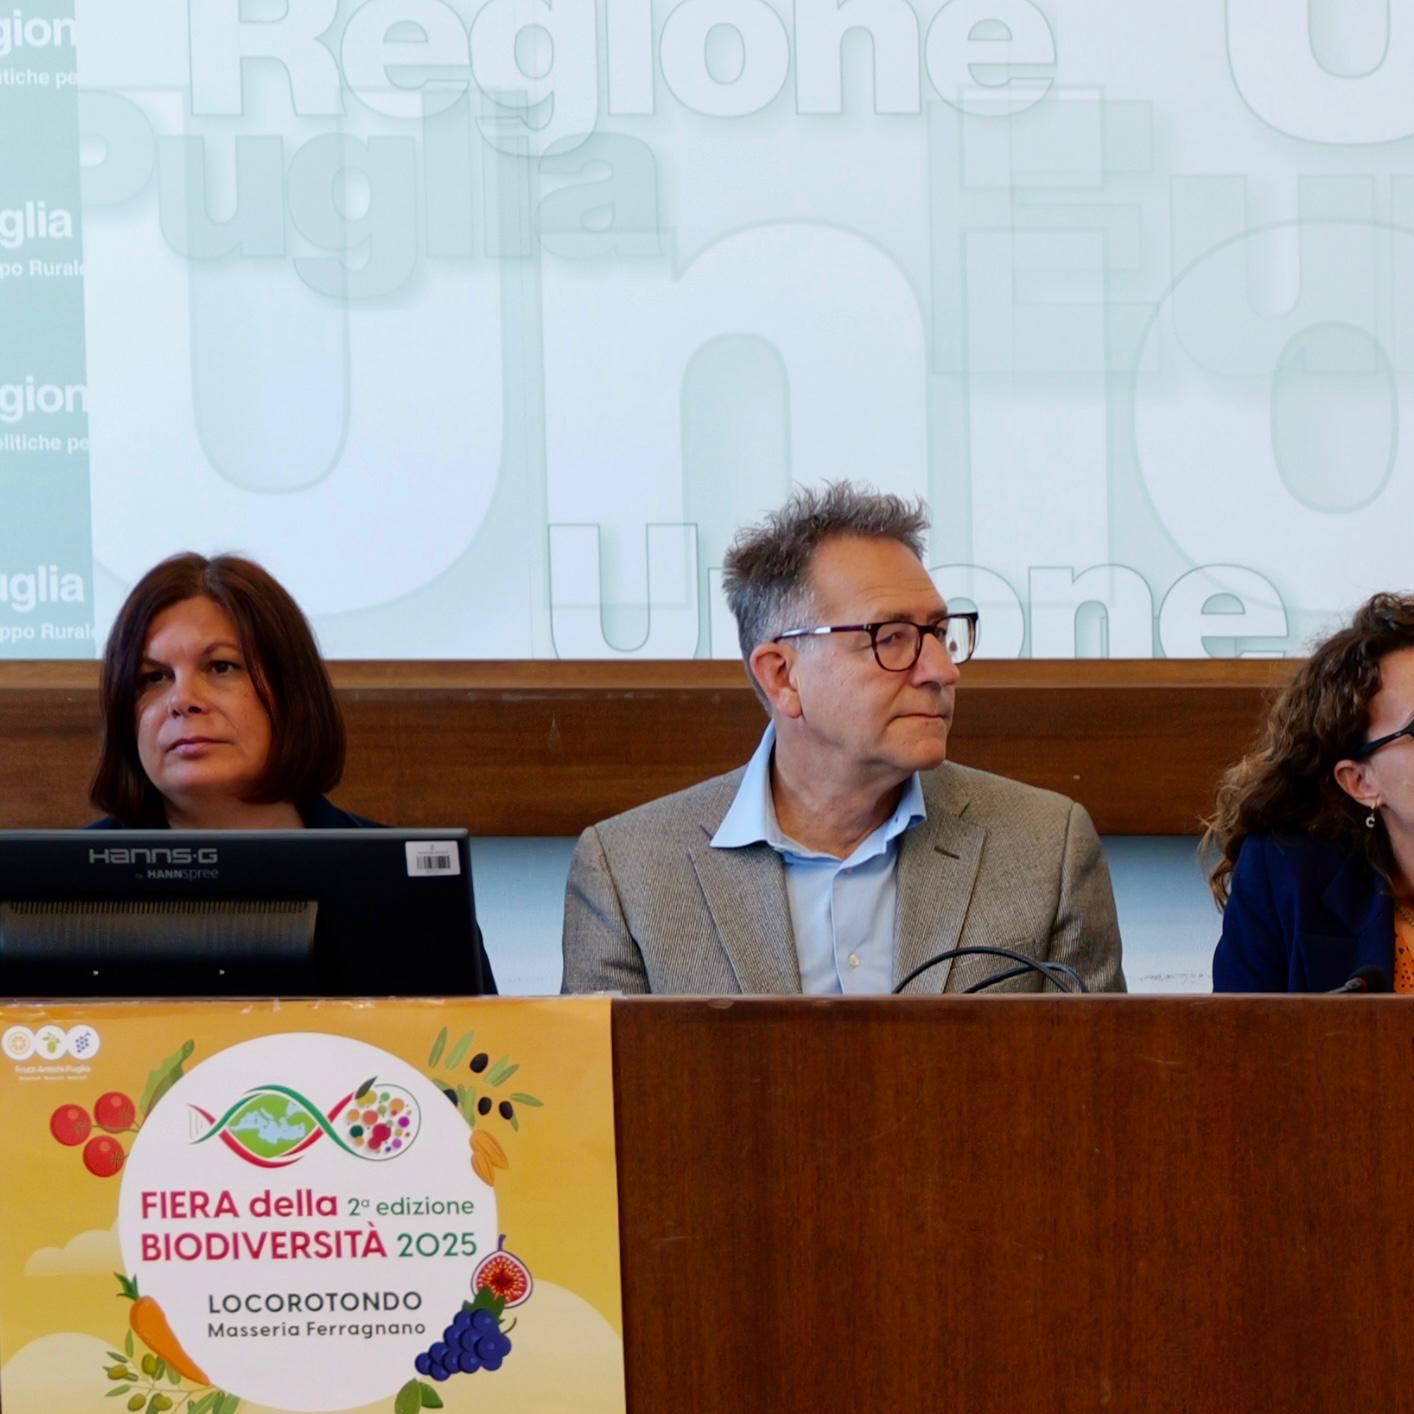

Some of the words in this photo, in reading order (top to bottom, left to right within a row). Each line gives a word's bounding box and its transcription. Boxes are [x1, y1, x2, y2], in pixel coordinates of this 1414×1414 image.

[141, 1190, 239, 1219] FIERA
[249, 1189, 337, 1218] della
[376, 1196, 474, 1216] edizione
[141, 1222, 387, 1261] BIODIVERSITÀ
[397, 1233, 477, 1258] 2025
[209, 1292, 422, 1314] LOCOROTONDO
[208, 1321, 300, 1338] Masseria
[306, 1321, 425, 1339] Ferragnano
